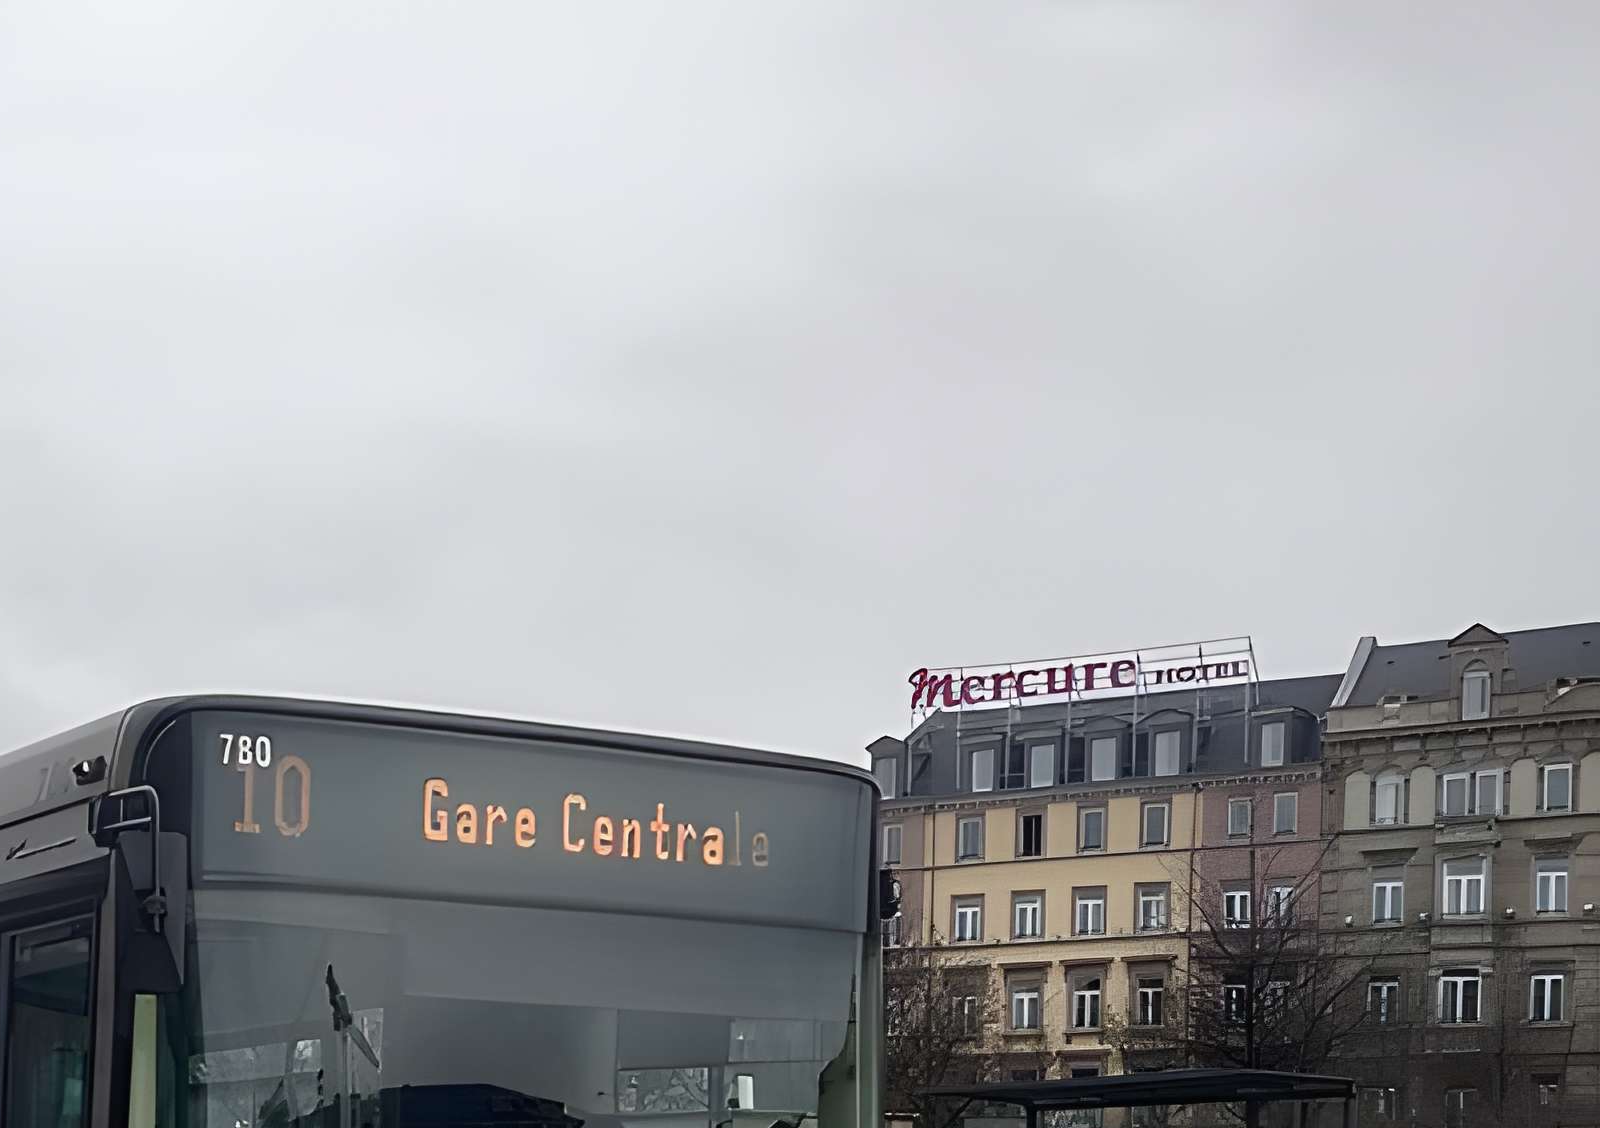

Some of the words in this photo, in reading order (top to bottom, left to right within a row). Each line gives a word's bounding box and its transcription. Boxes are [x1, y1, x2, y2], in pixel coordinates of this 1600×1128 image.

[220, 733, 271, 768] 780
[234, 754, 311, 837] 10
[423, 777, 536, 848] Gare
[562, 793, 769, 868] Centrale
